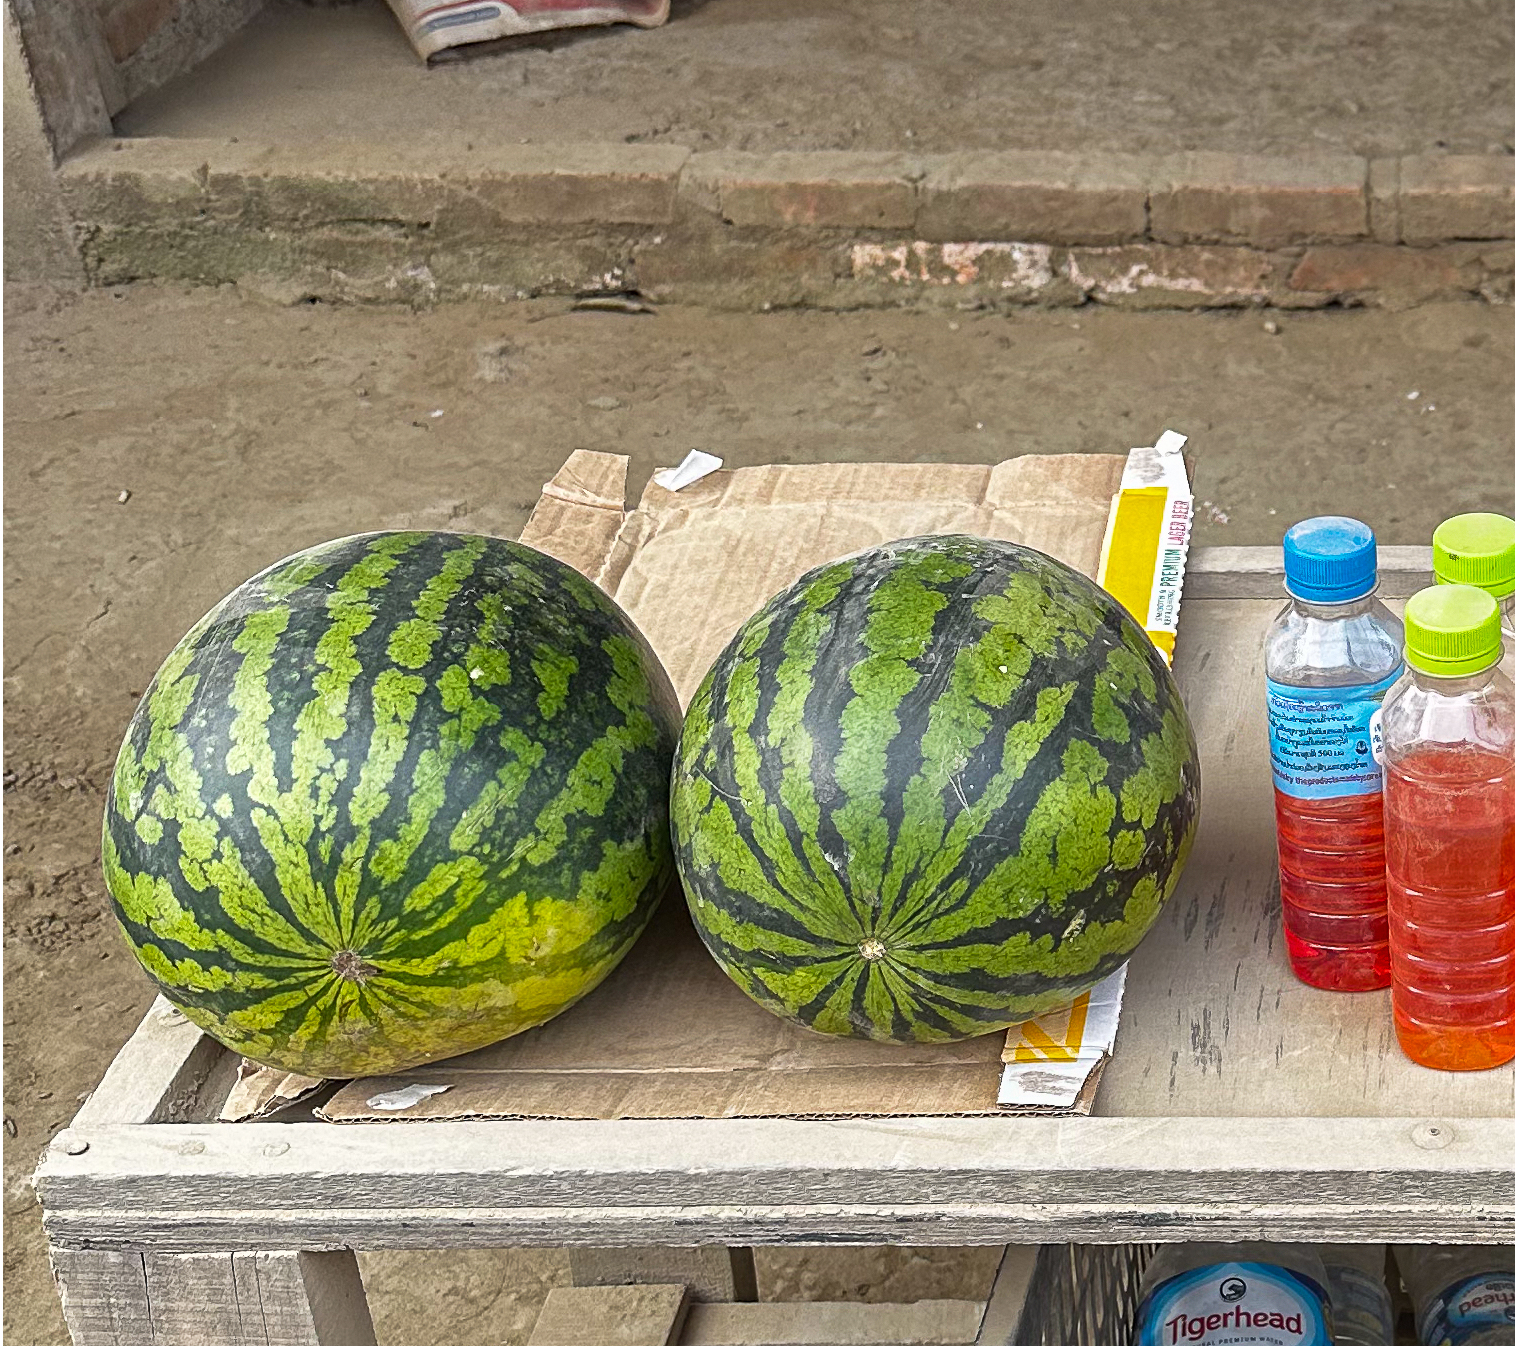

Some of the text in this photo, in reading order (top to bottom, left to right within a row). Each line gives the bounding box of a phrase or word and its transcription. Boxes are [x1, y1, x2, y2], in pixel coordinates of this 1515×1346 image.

[1159, 548, 1183, 587] PREMIUM
[1165, 1304, 1303, 1346] Tigerhead
[1218, 1337, 1257, 1345] PREMIUM
[1258, 1336, 1284, 1346] WATER
